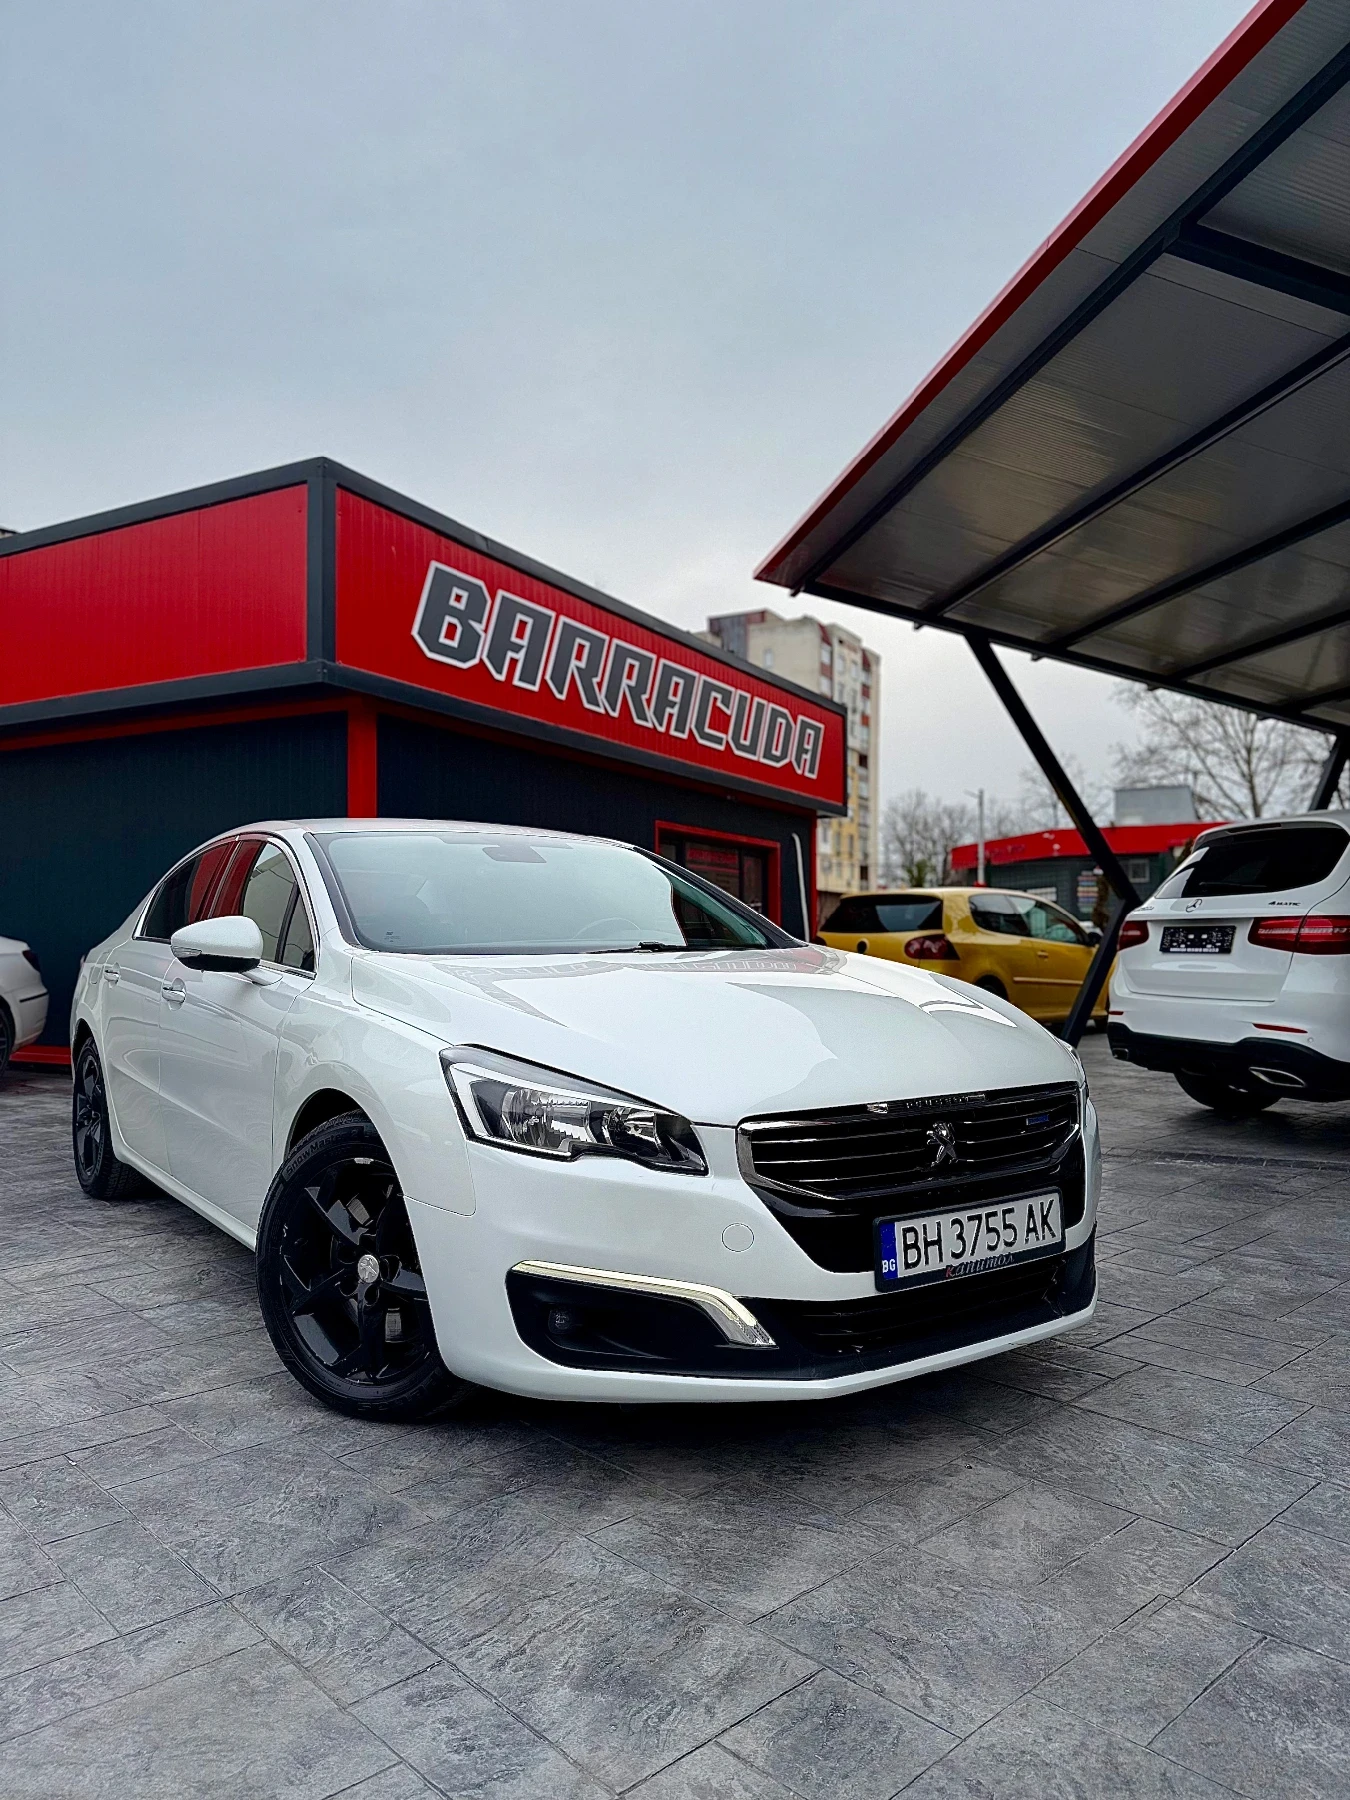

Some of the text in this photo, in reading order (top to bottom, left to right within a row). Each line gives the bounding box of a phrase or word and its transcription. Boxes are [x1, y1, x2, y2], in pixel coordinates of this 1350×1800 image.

[411, 560, 824, 779] BARRACUDA
[882, 1258, 895, 1273] BG
[901, 1199, 1056, 1270] BH 3755 AK
